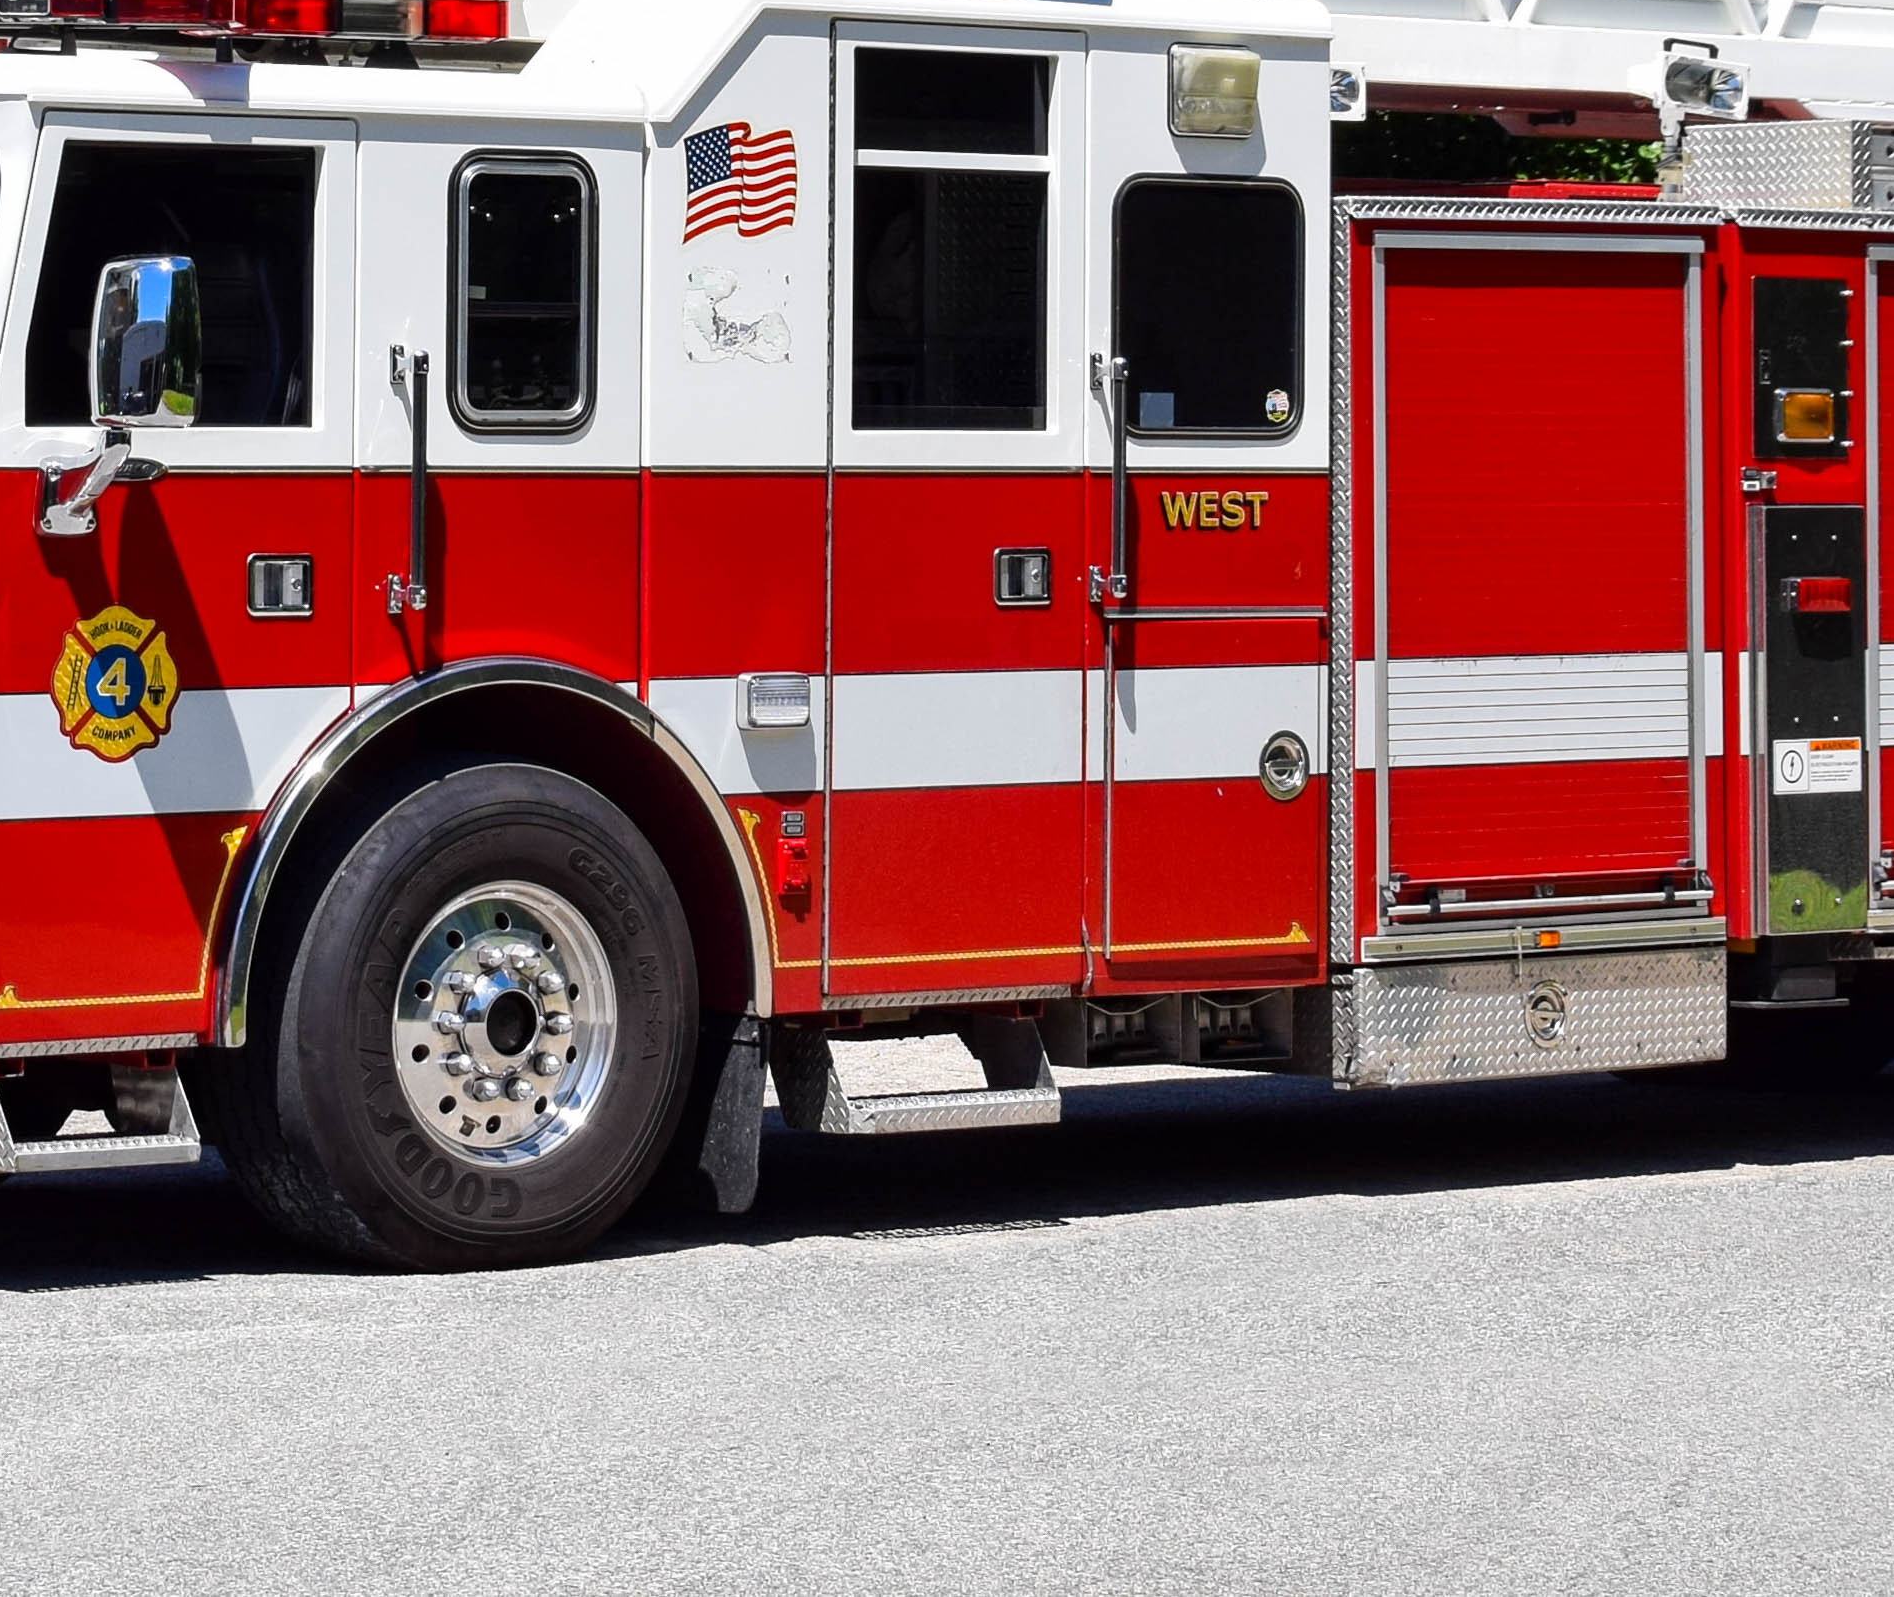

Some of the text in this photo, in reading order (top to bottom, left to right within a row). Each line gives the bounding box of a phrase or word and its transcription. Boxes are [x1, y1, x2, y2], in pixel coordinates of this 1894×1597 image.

[1160, 490, 1269, 529] WEST
[114, 619, 143, 640] LADDER
[96, 657, 131, 706] 4
[91, 725, 137, 741] COMPANY
[568, 847, 648, 937] G296
[356, 906, 523, 1220] GOODYEAR
